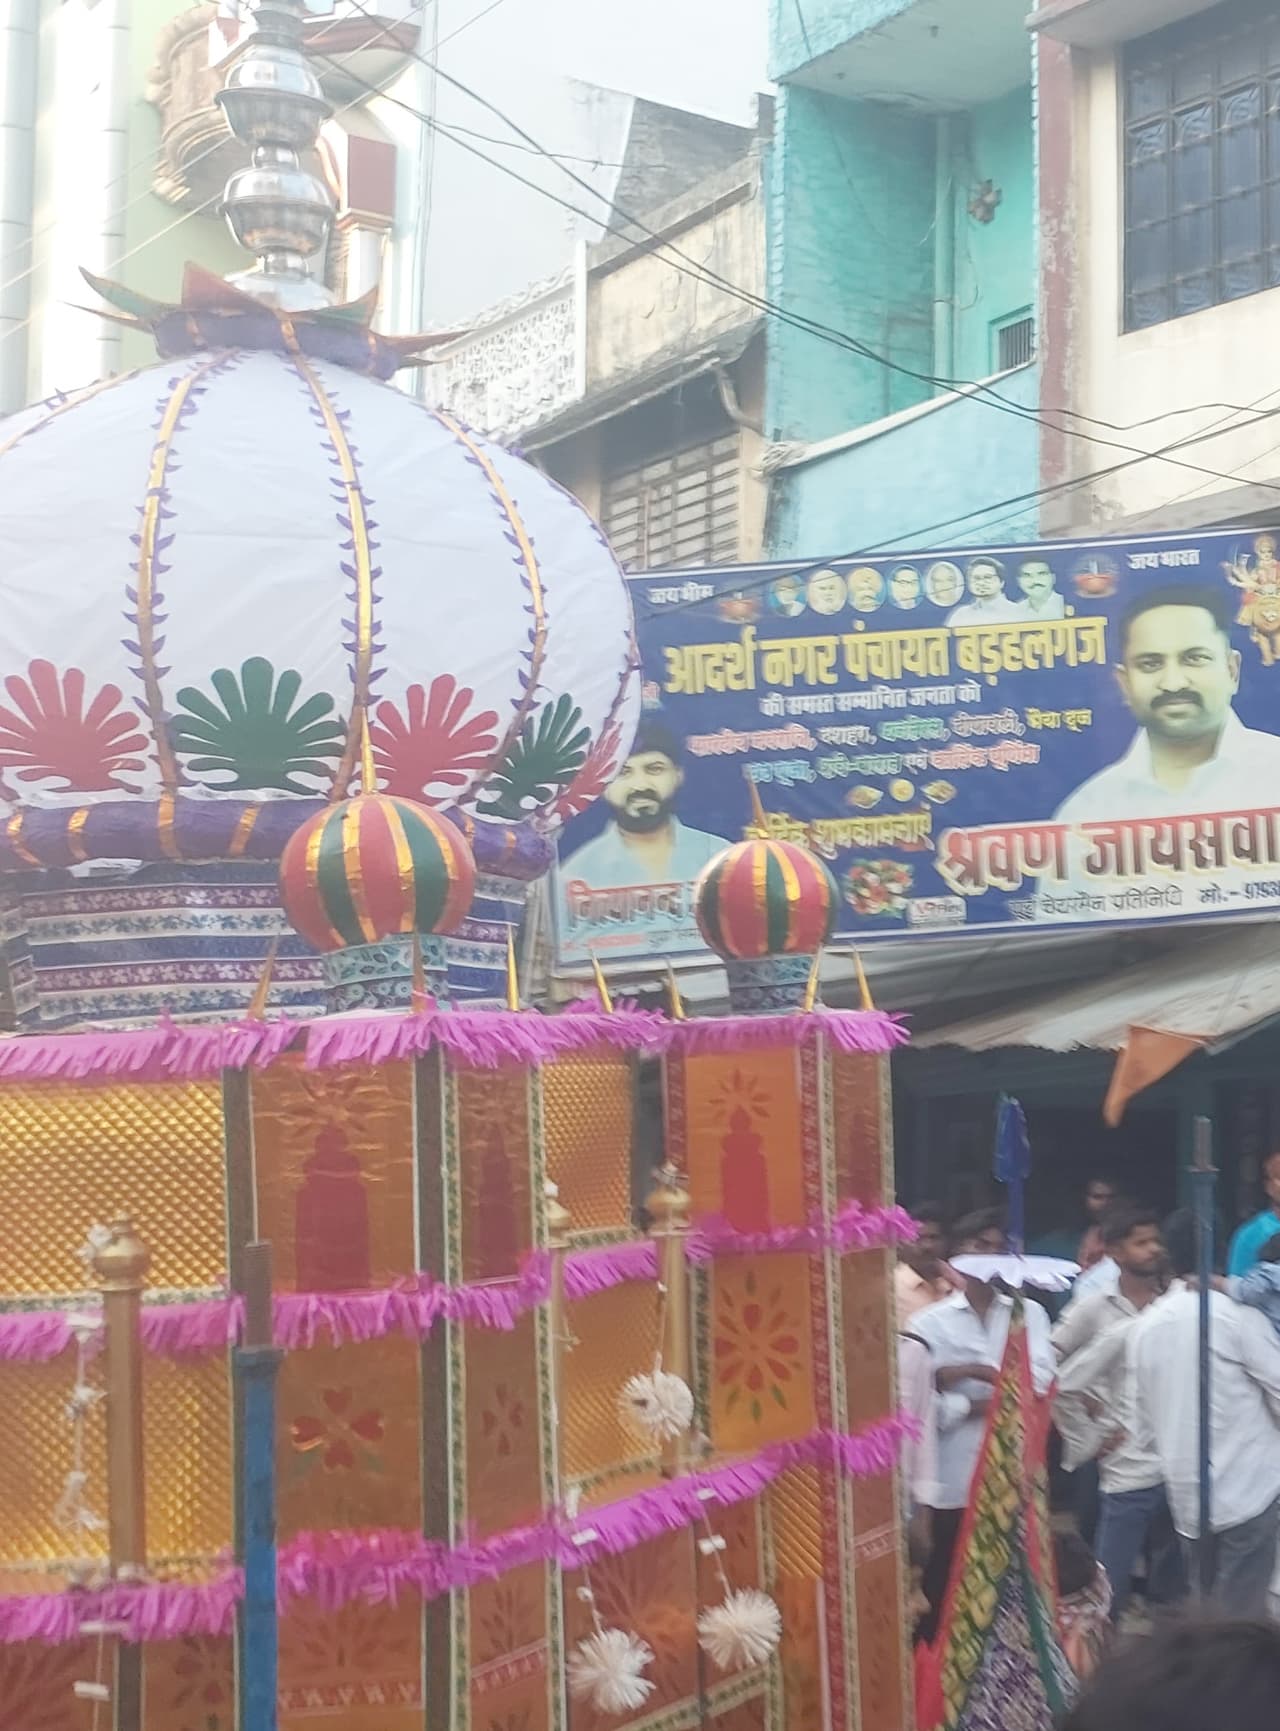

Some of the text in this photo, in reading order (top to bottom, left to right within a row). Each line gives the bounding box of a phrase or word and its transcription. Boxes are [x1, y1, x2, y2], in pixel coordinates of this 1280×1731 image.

[663, 625, 757, 695] आदर्श
[758, 635, 839, 687] नगर
[841, 618, 950, 681] पंचायत
[952, 604, 1108, 686] बड़हलगंज
[956, 679, 982, 703] को
[937, 822, 1071, 895] श्रवण
